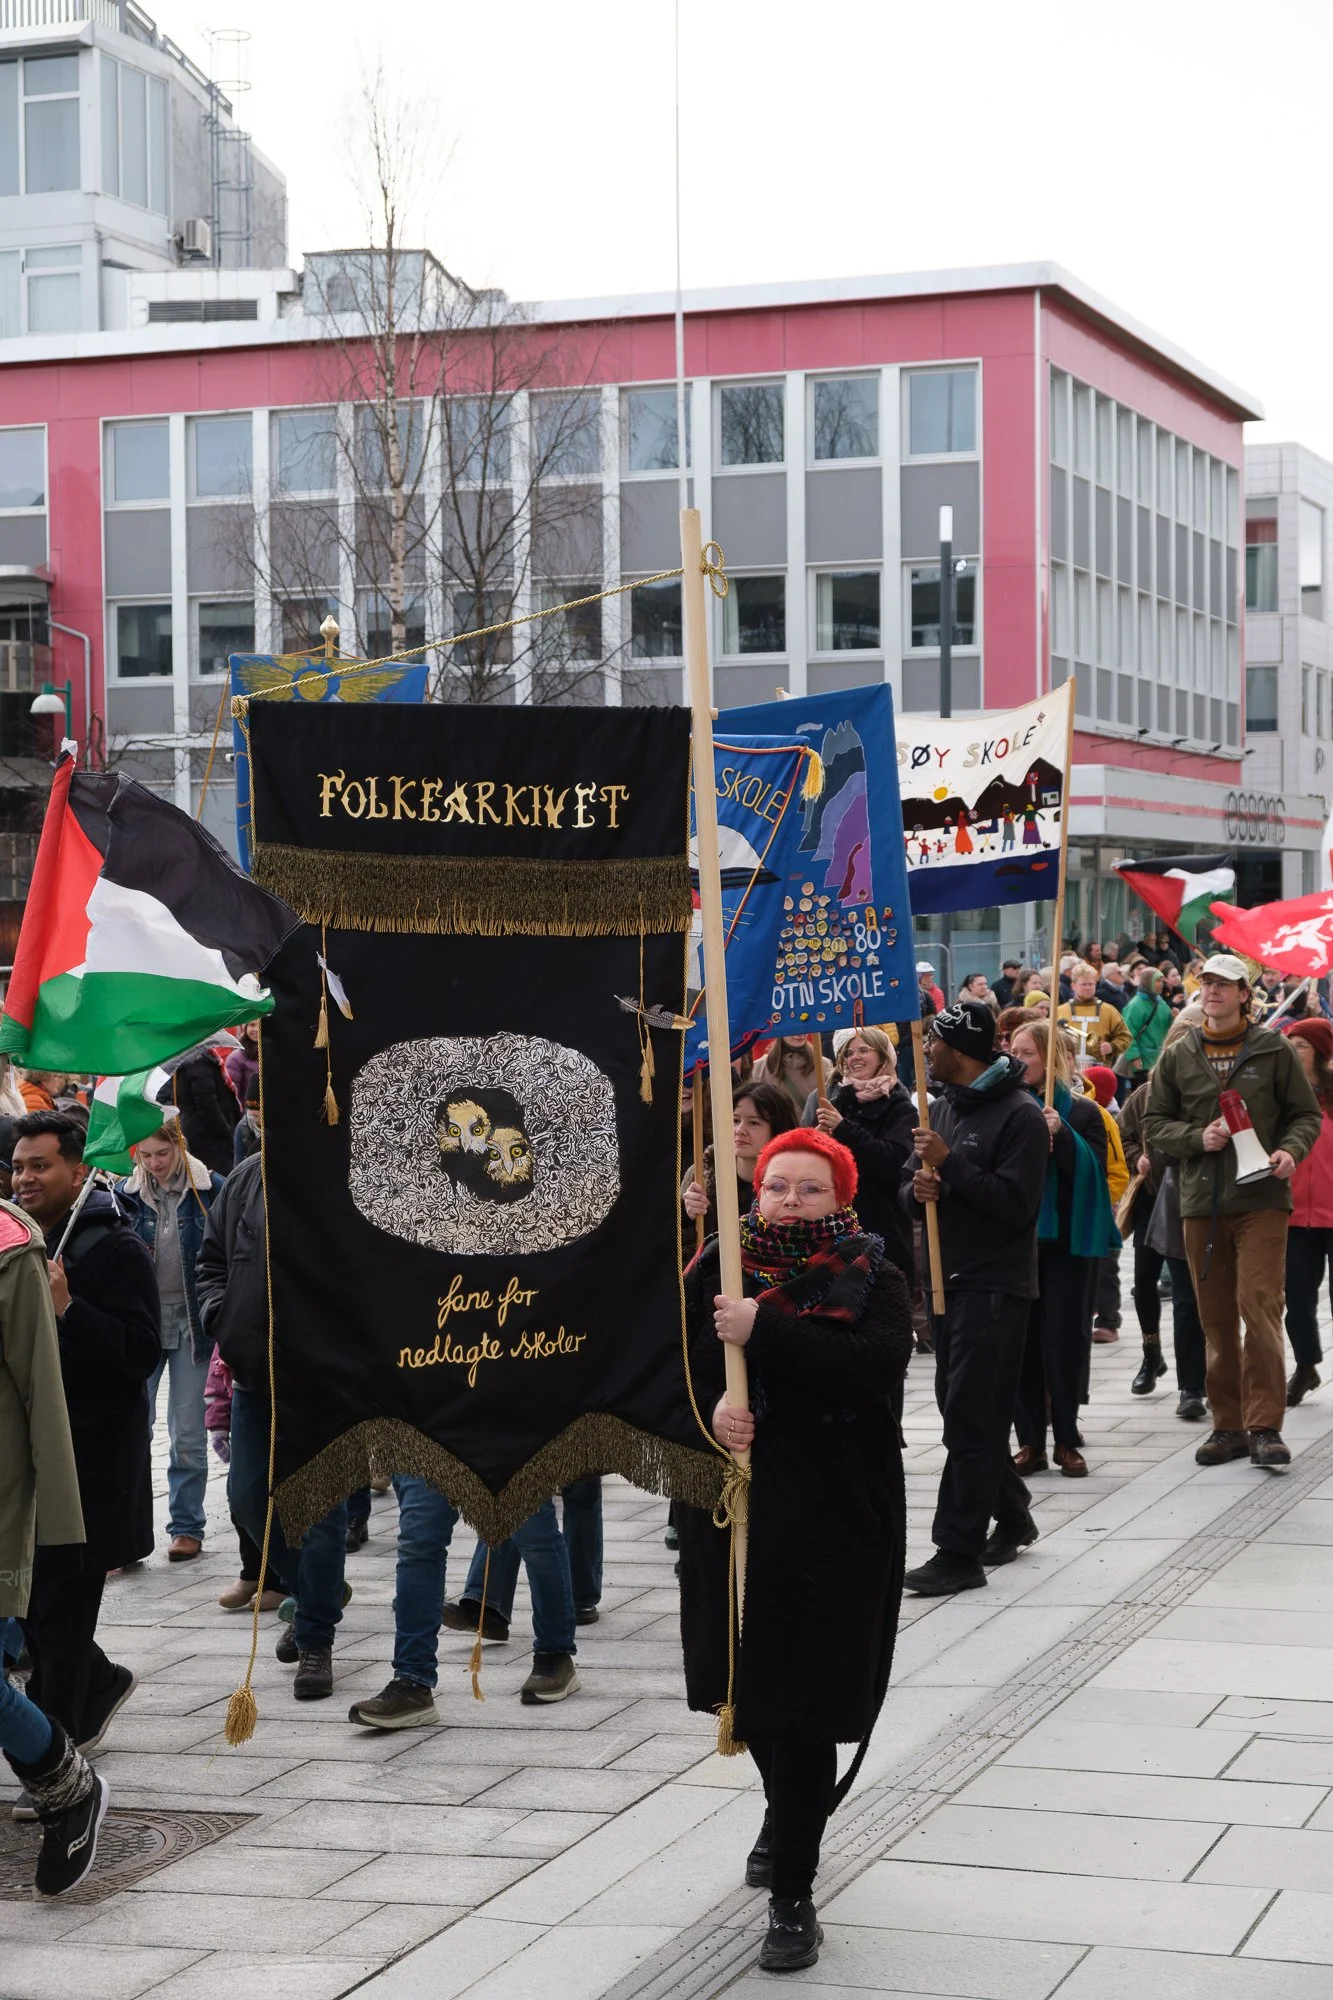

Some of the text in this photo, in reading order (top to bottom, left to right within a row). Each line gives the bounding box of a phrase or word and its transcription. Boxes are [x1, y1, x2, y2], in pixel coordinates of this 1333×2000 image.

[963, 725, 1037, 768] SKOLE
[316, 769, 630, 829] FOLKEARKIVET
[715, 767, 788, 824] SKOLE
[854, 922, 882, 953] 80
[818, 970, 886, 1004] SKOLE
[437, 1274, 539, 1329] fane for
[397, 1332, 504, 1388] nedlagte
